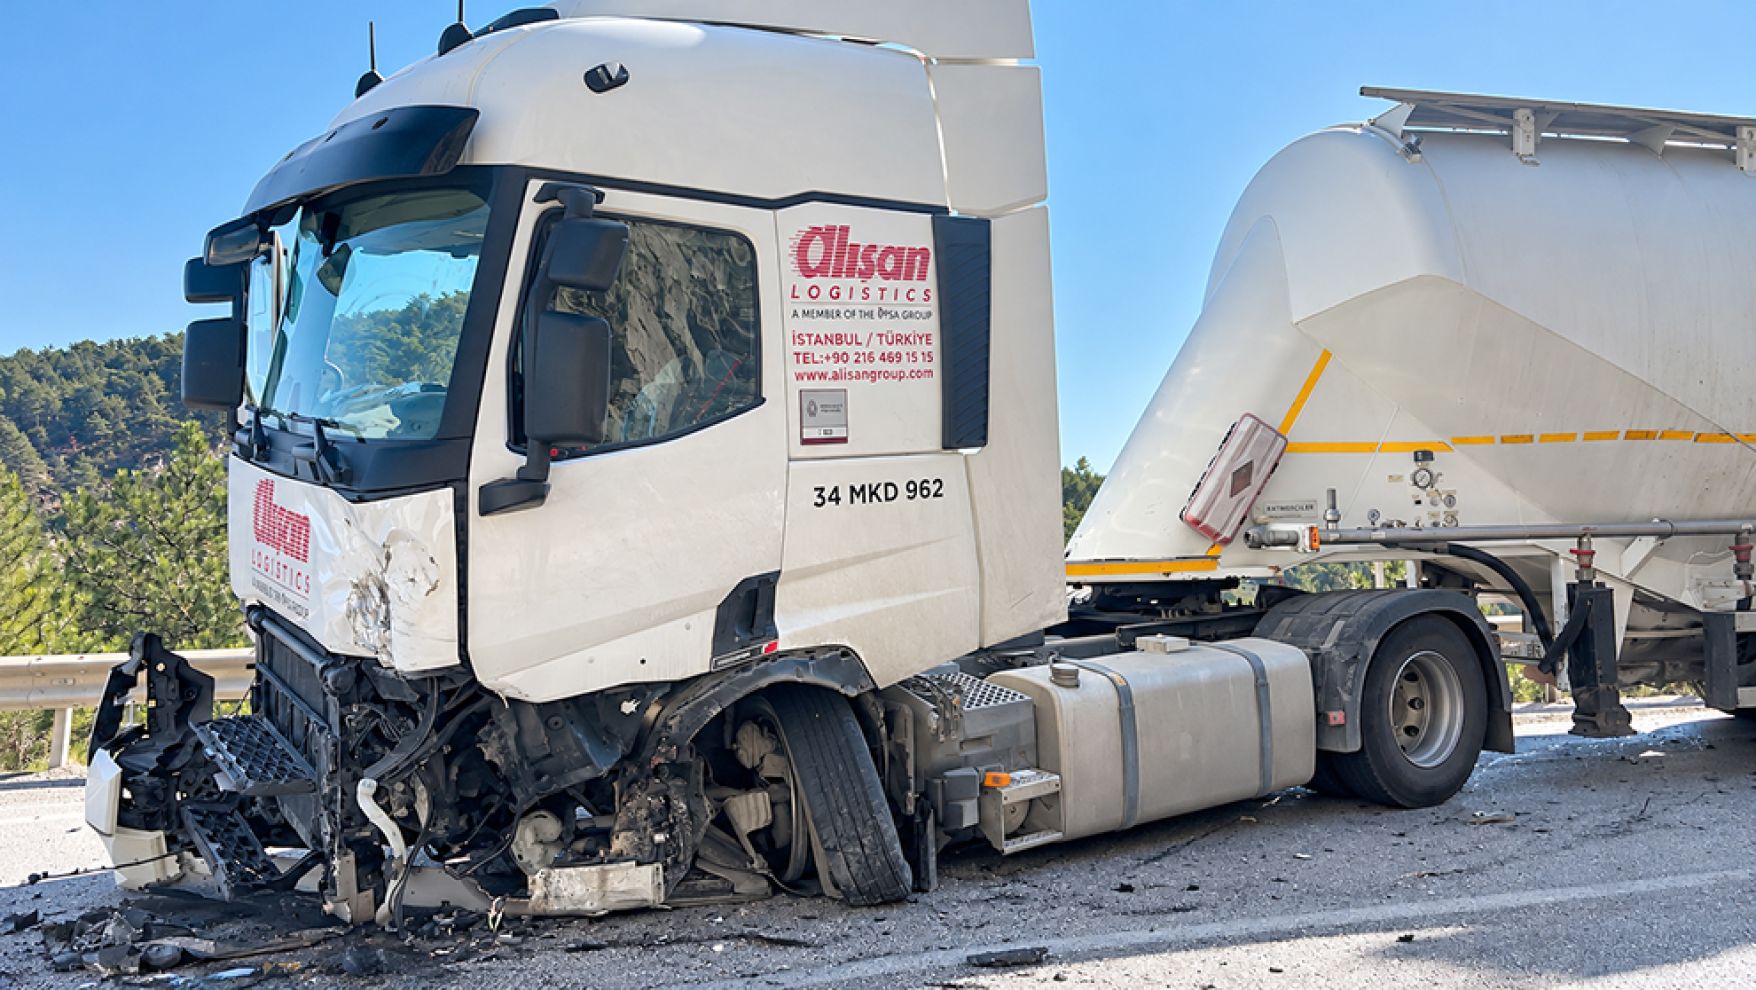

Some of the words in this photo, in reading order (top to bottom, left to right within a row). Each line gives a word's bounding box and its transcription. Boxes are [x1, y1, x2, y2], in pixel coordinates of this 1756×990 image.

[791, 285, 931, 302] LOGISTICS
[791, 308, 799, 319] A
[802, 309, 840, 319] MEMBER
[844, 310, 856, 319] OF
[859, 310, 874, 319] THE
[901, 311, 931, 320] GROUP
[792, 330, 862, 346] İSTANBUL
[866, 332, 873, 348] /
[877, 330, 932, 345] TÜRKİYE
[793, 352, 849, 364] TEL:+90
[854, 352, 875, 364] 216
[879, 351, 902, 363] 469
[906, 351, 917, 363] 15
[922, 351, 933, 363] 15
[794, 367, 933, 383] www.alisangroup.com
[813, 485, 841, 508] 34
[850, 482, 898, 504] MKD
[906, 478, 943, 500] 962
[251, 548, 310, 594] LOGISTICS
